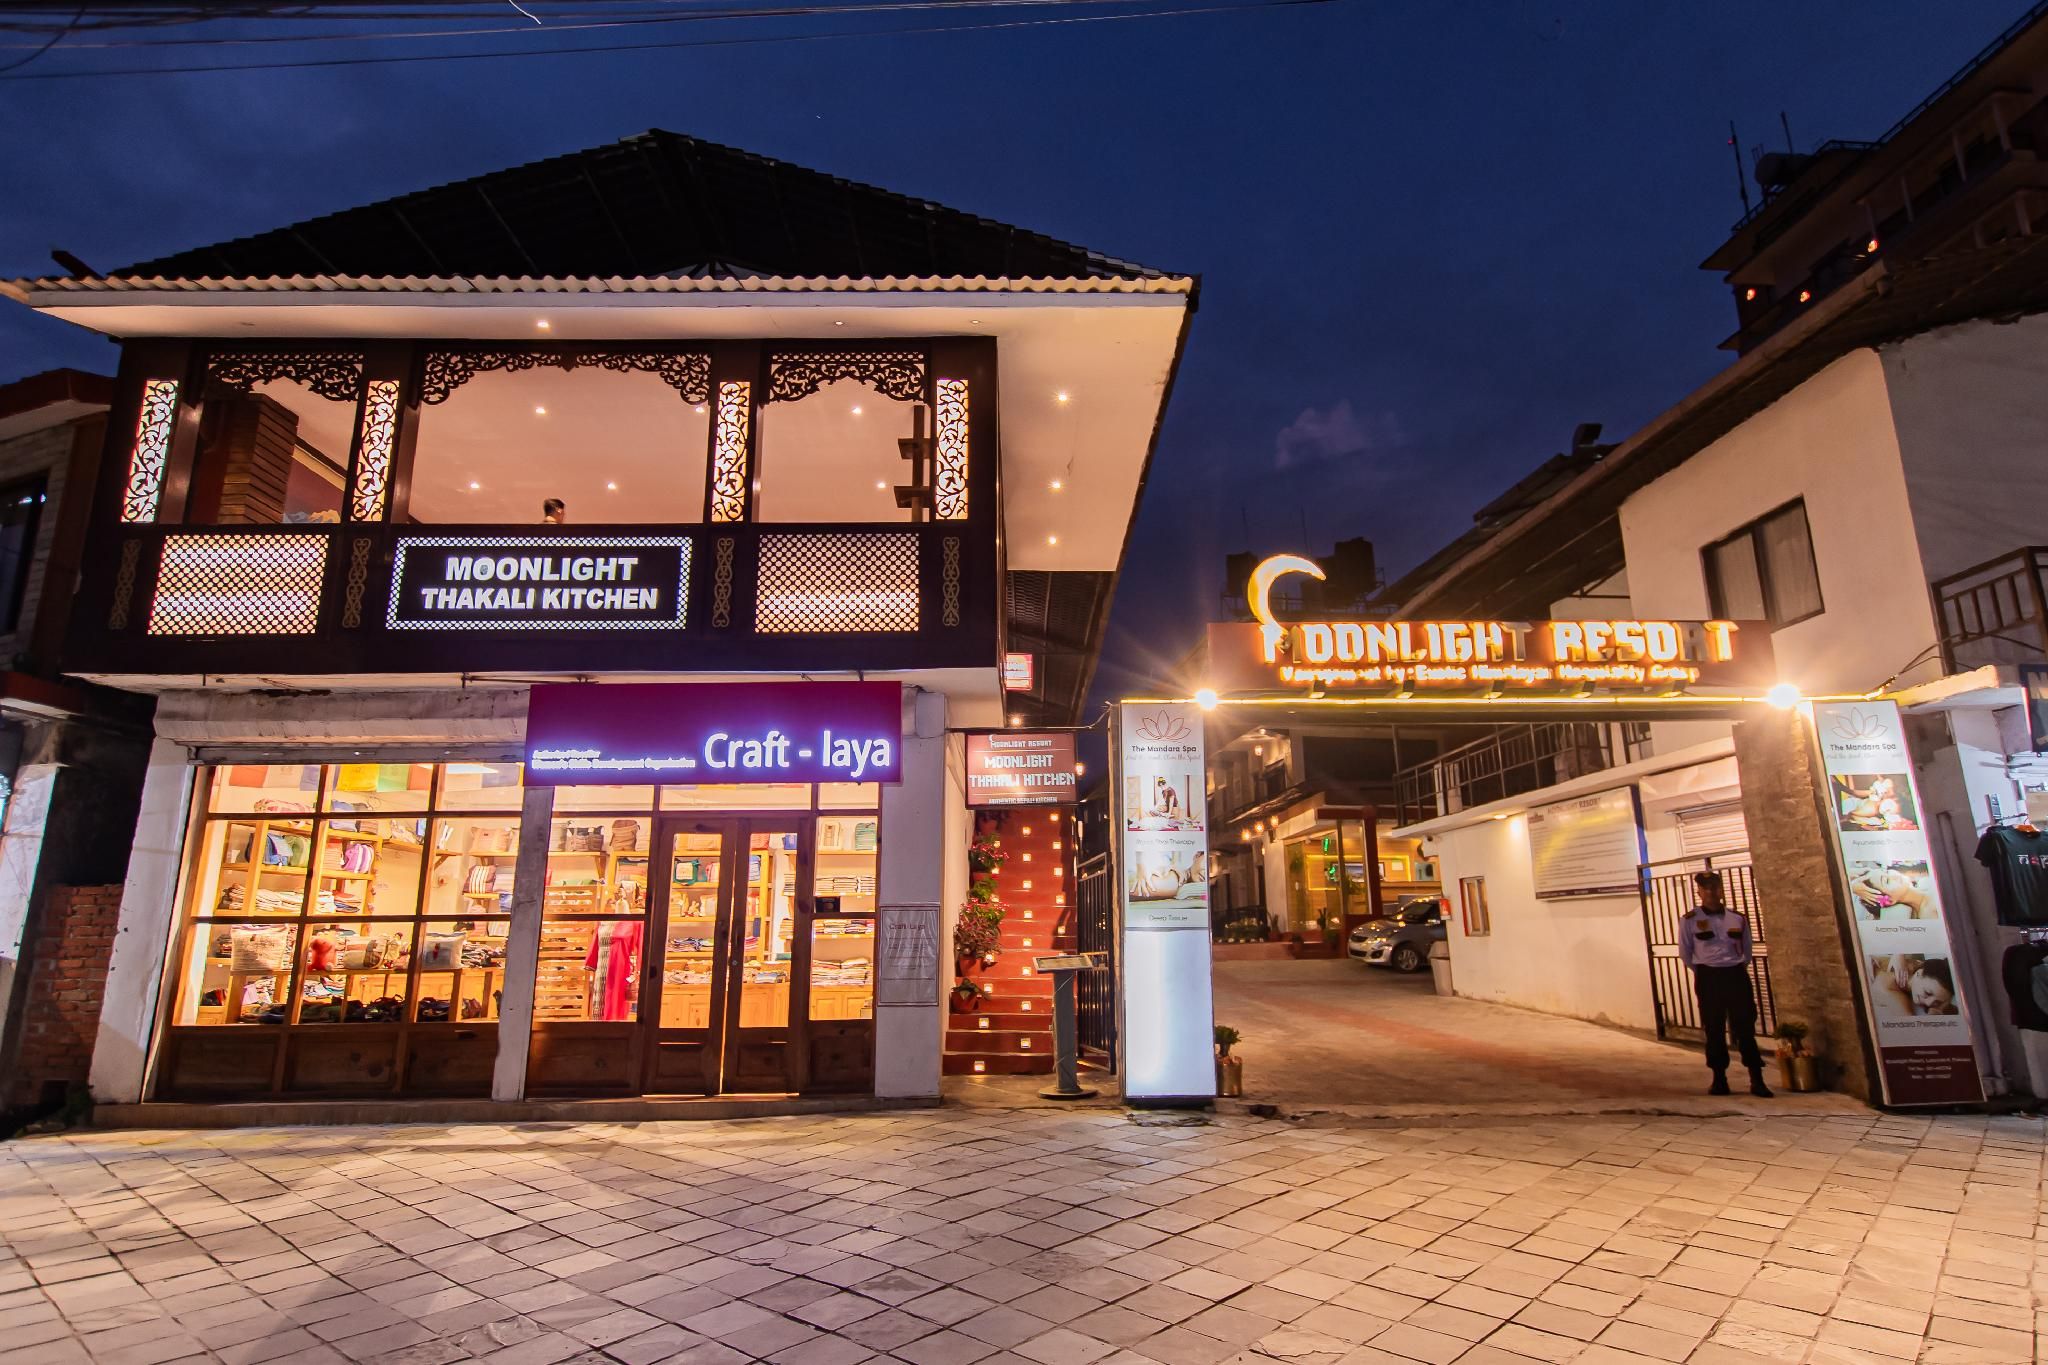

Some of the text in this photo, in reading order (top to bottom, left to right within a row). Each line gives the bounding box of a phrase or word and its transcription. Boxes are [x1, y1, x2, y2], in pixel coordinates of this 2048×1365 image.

[445, 557, 639, 581] MOONLIGHT
[421, 588, 658, 610] THAKALI KITCHEN
[1259, 621, 1740, 663] MOONLIGHT RESORT
[990, 739, 1052, 749] MOONLIGHT RESORT
[1131, 745, 1197, 754] The Mandara Spa
[1845, 743, 1880, 751] Mandara
[1882, 743, 1897, 752] Spa
[704, 730, 790, 768] Craft
[823, 730, 890, 777] laya
[984, 754, 1054, 769] MOONLIGHT
[968, 772, 1076, 788] THAKALI KITCHEN
